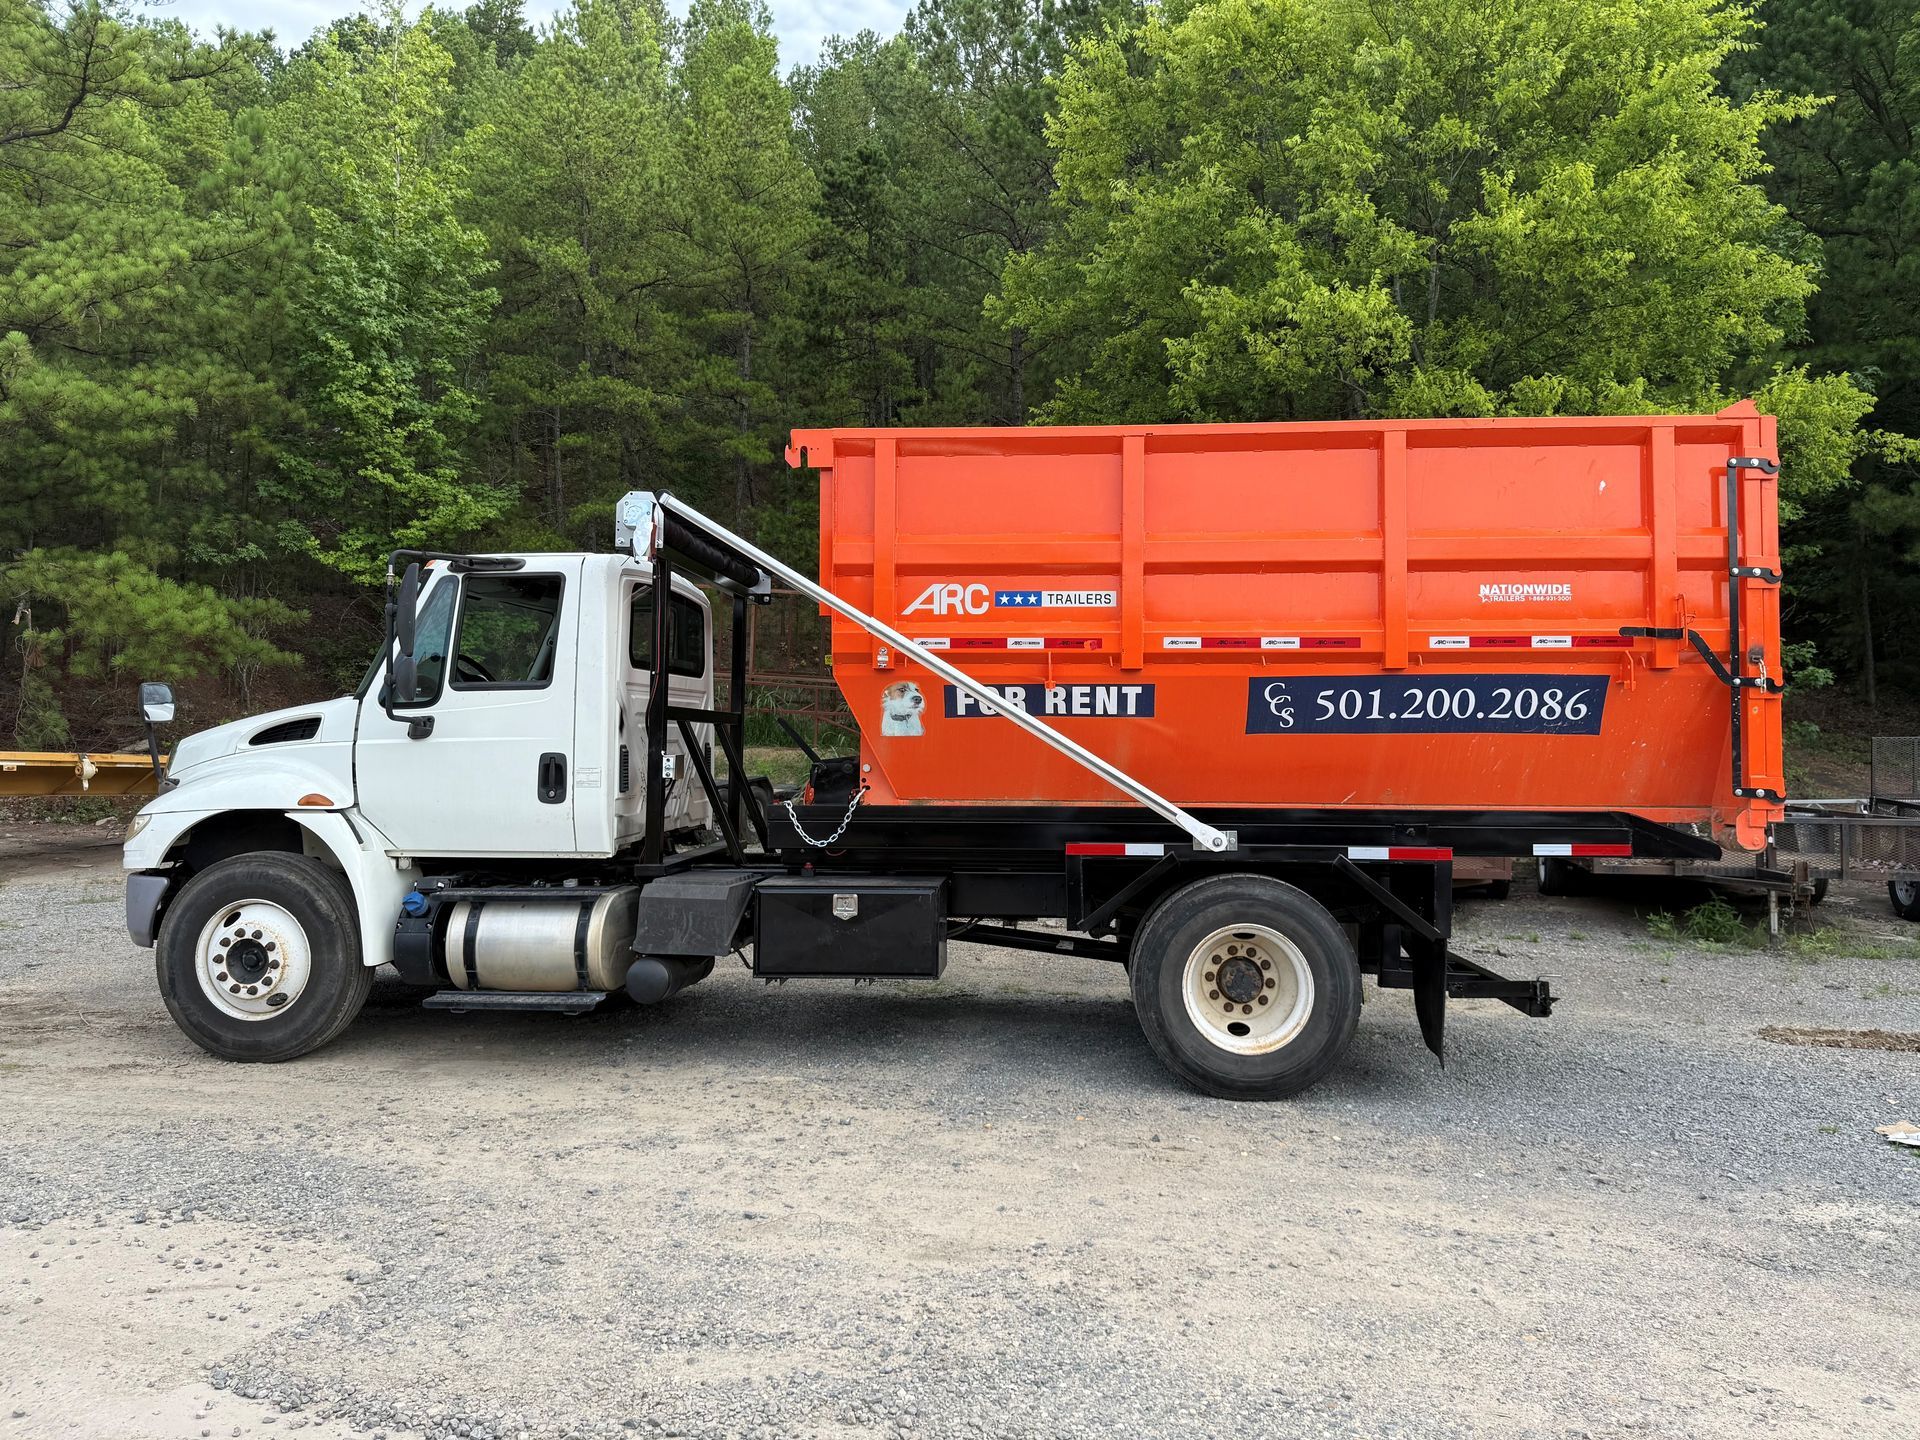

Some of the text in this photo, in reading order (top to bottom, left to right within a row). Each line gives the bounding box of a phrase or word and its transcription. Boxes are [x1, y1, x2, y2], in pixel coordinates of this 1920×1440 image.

[901, 583, 1112, 615] ARC TRAILERS
[1480, 583, 1572, 595] NATIONWIDE
[1045, 686, 1143, 715] RENT
[1315, 688, 1591, 721] 501.200.2086
